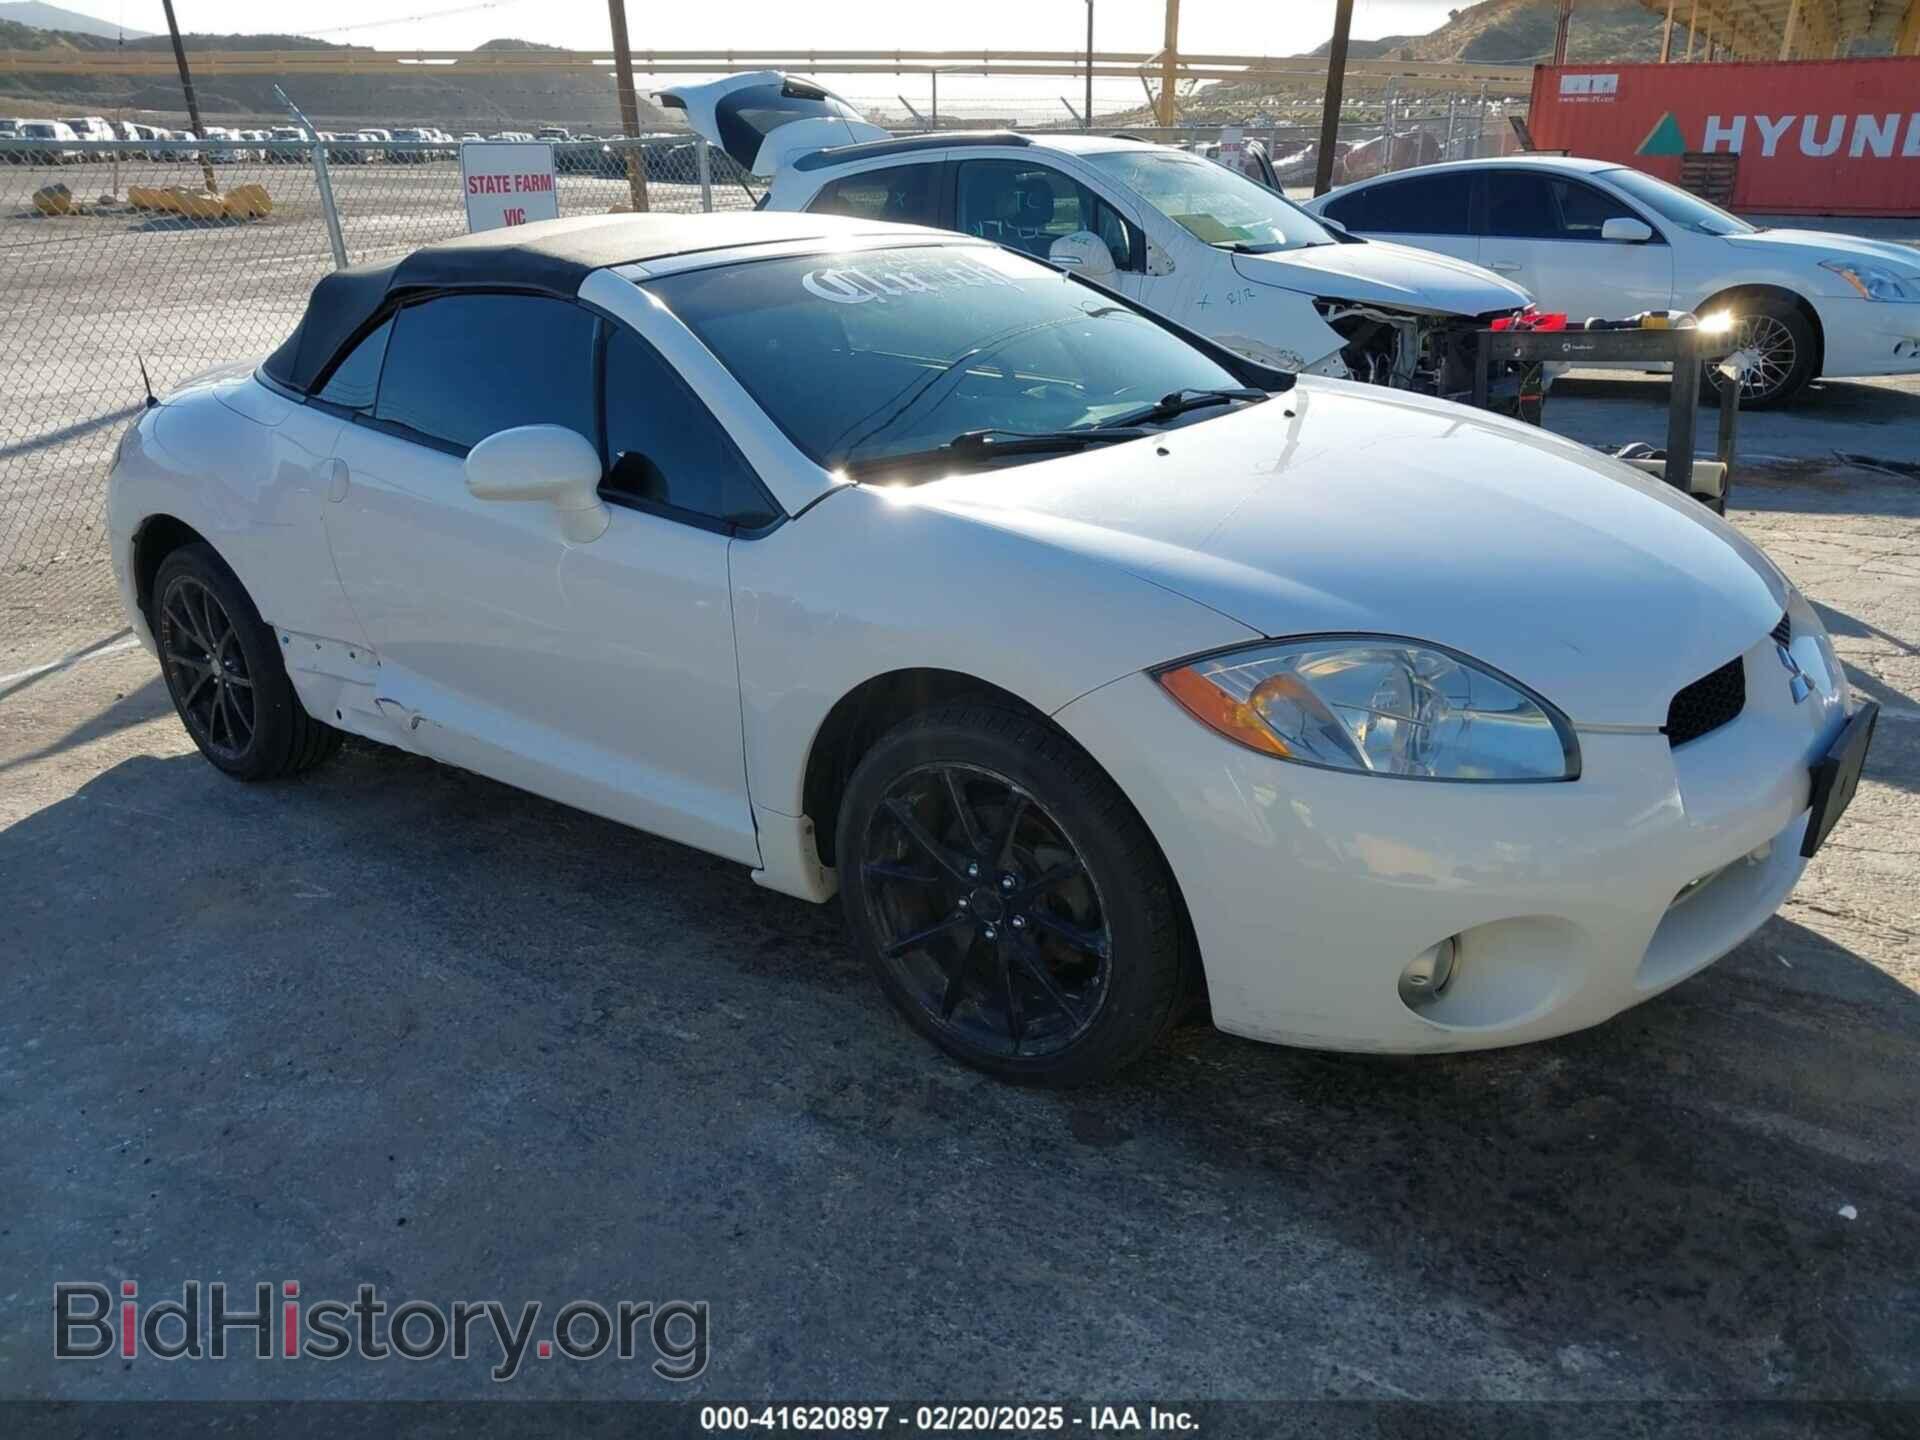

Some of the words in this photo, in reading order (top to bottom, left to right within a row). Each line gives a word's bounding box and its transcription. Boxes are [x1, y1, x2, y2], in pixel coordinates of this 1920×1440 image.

[468, 175, 511, 194] STATE
[514, 174, 553, 192] FARM
[504, 208, 526, 226] VIC
